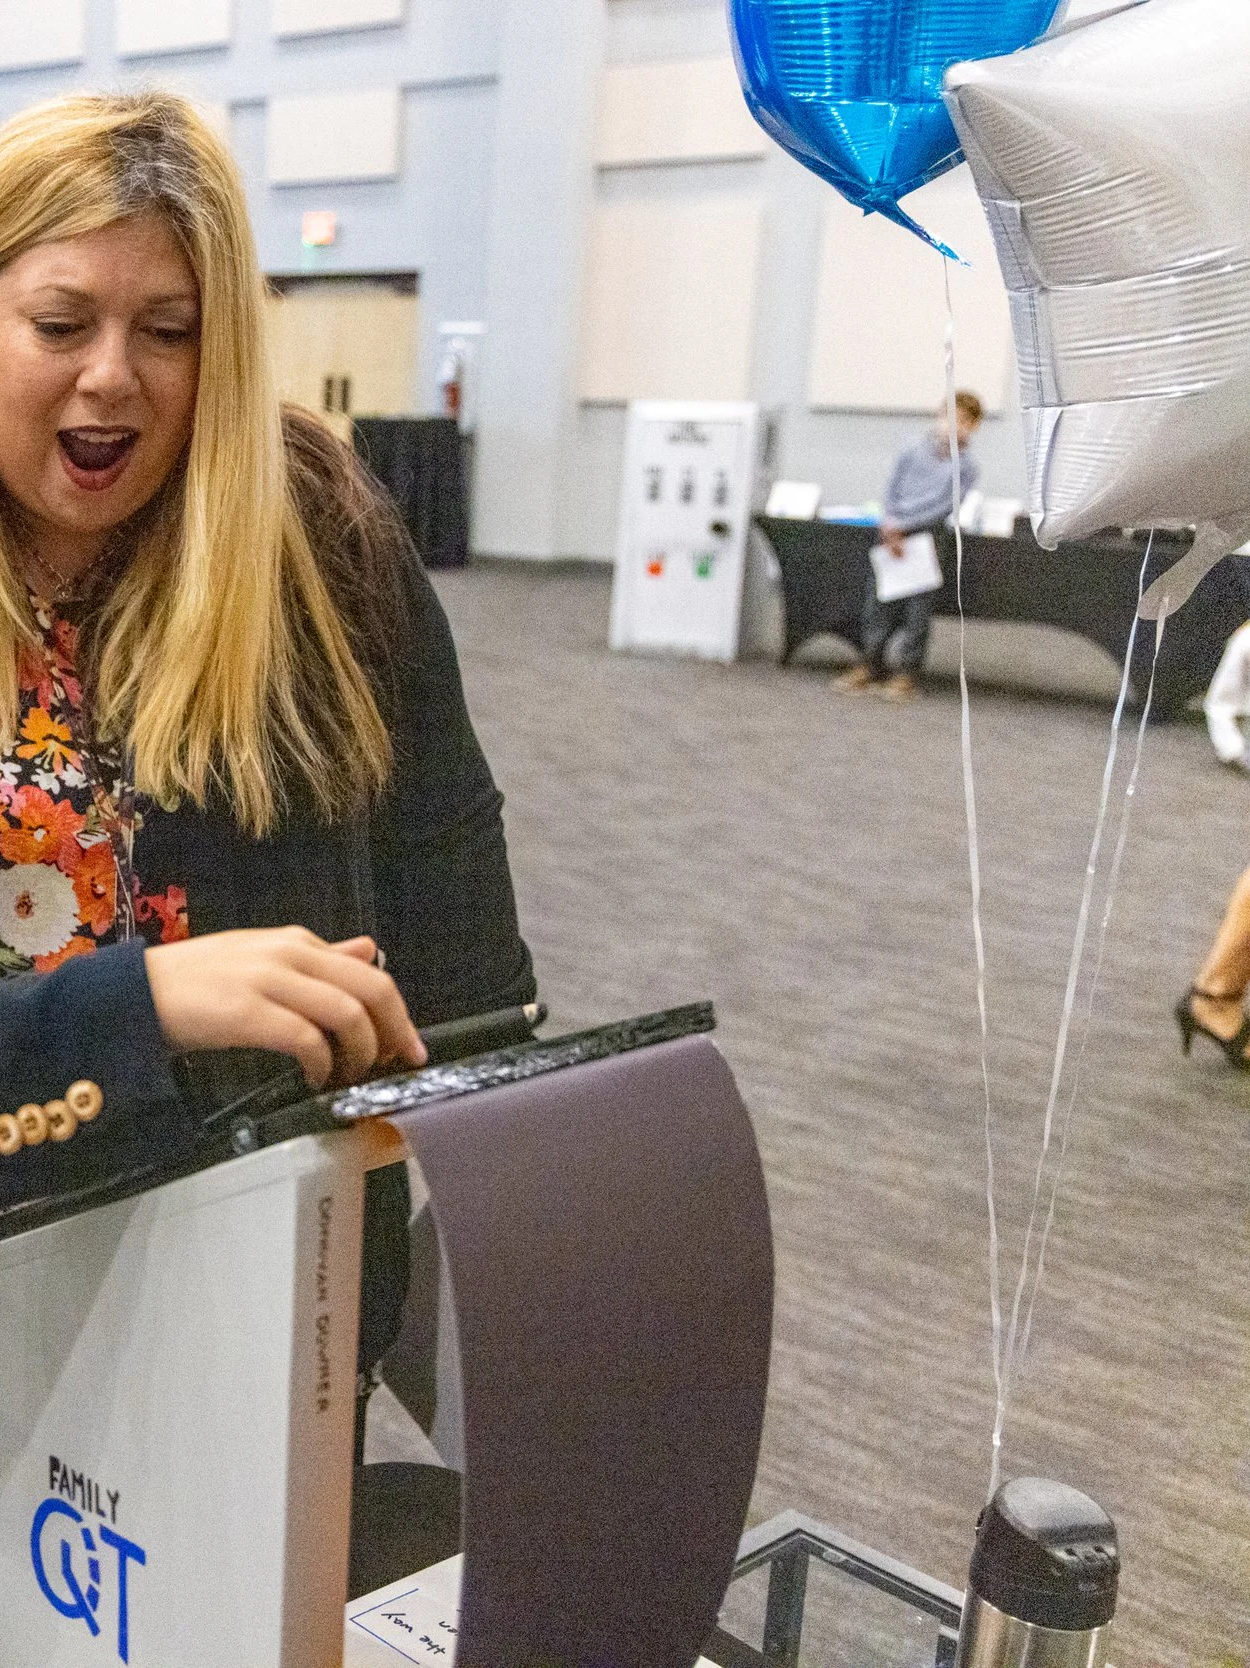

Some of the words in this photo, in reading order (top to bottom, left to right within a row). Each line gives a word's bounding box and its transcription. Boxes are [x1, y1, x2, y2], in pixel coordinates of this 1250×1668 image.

[49, 1455, 120, 1525] FAMILY
[380, 1613, 413, 1633] way
[419, 1635, 446, 1655] the
